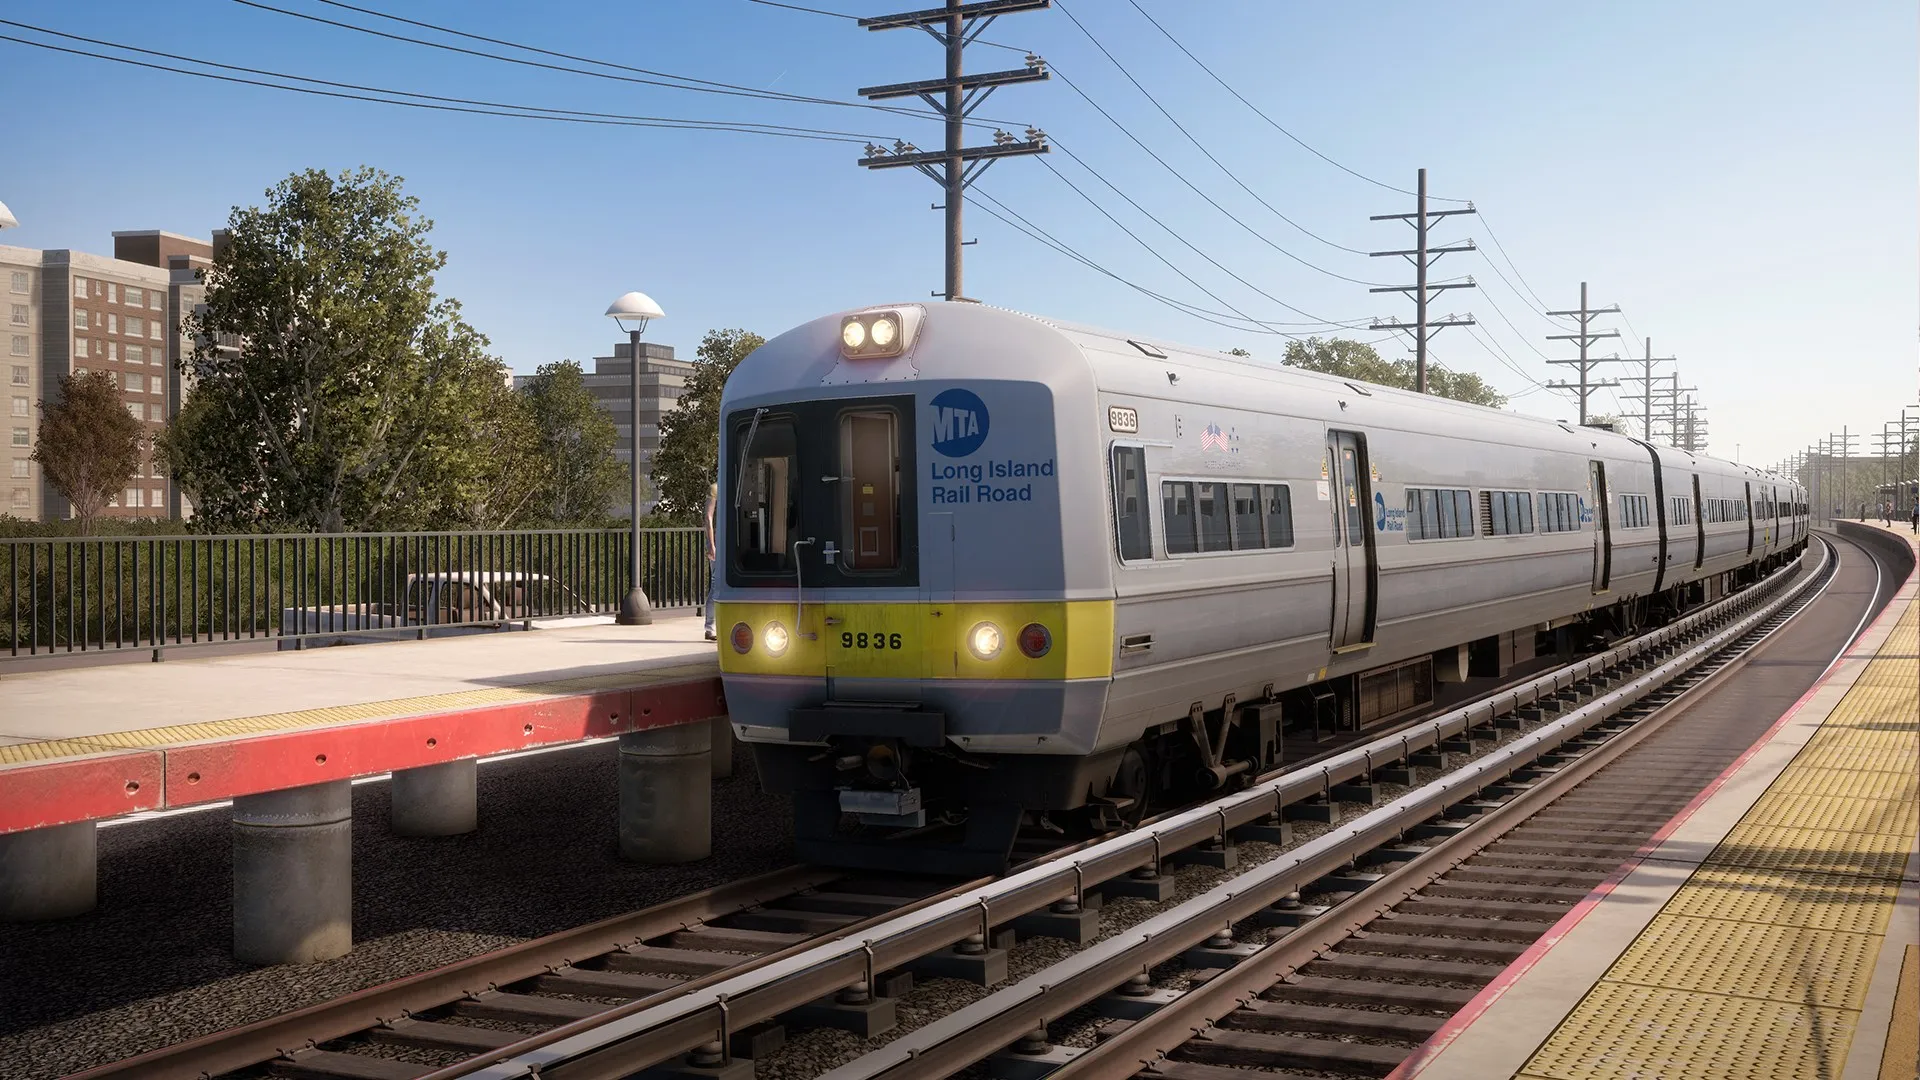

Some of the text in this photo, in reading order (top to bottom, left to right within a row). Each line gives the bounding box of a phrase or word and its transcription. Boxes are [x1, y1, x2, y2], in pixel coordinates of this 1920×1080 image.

[929, 405, 979, 445] MTA
[1111, 410, 1136, 427] 9836
[931, 459, 1054, 483] Long Island
[932, 484, 1032, 504] Rail Road
[841, 631, 902, 650] 9836
